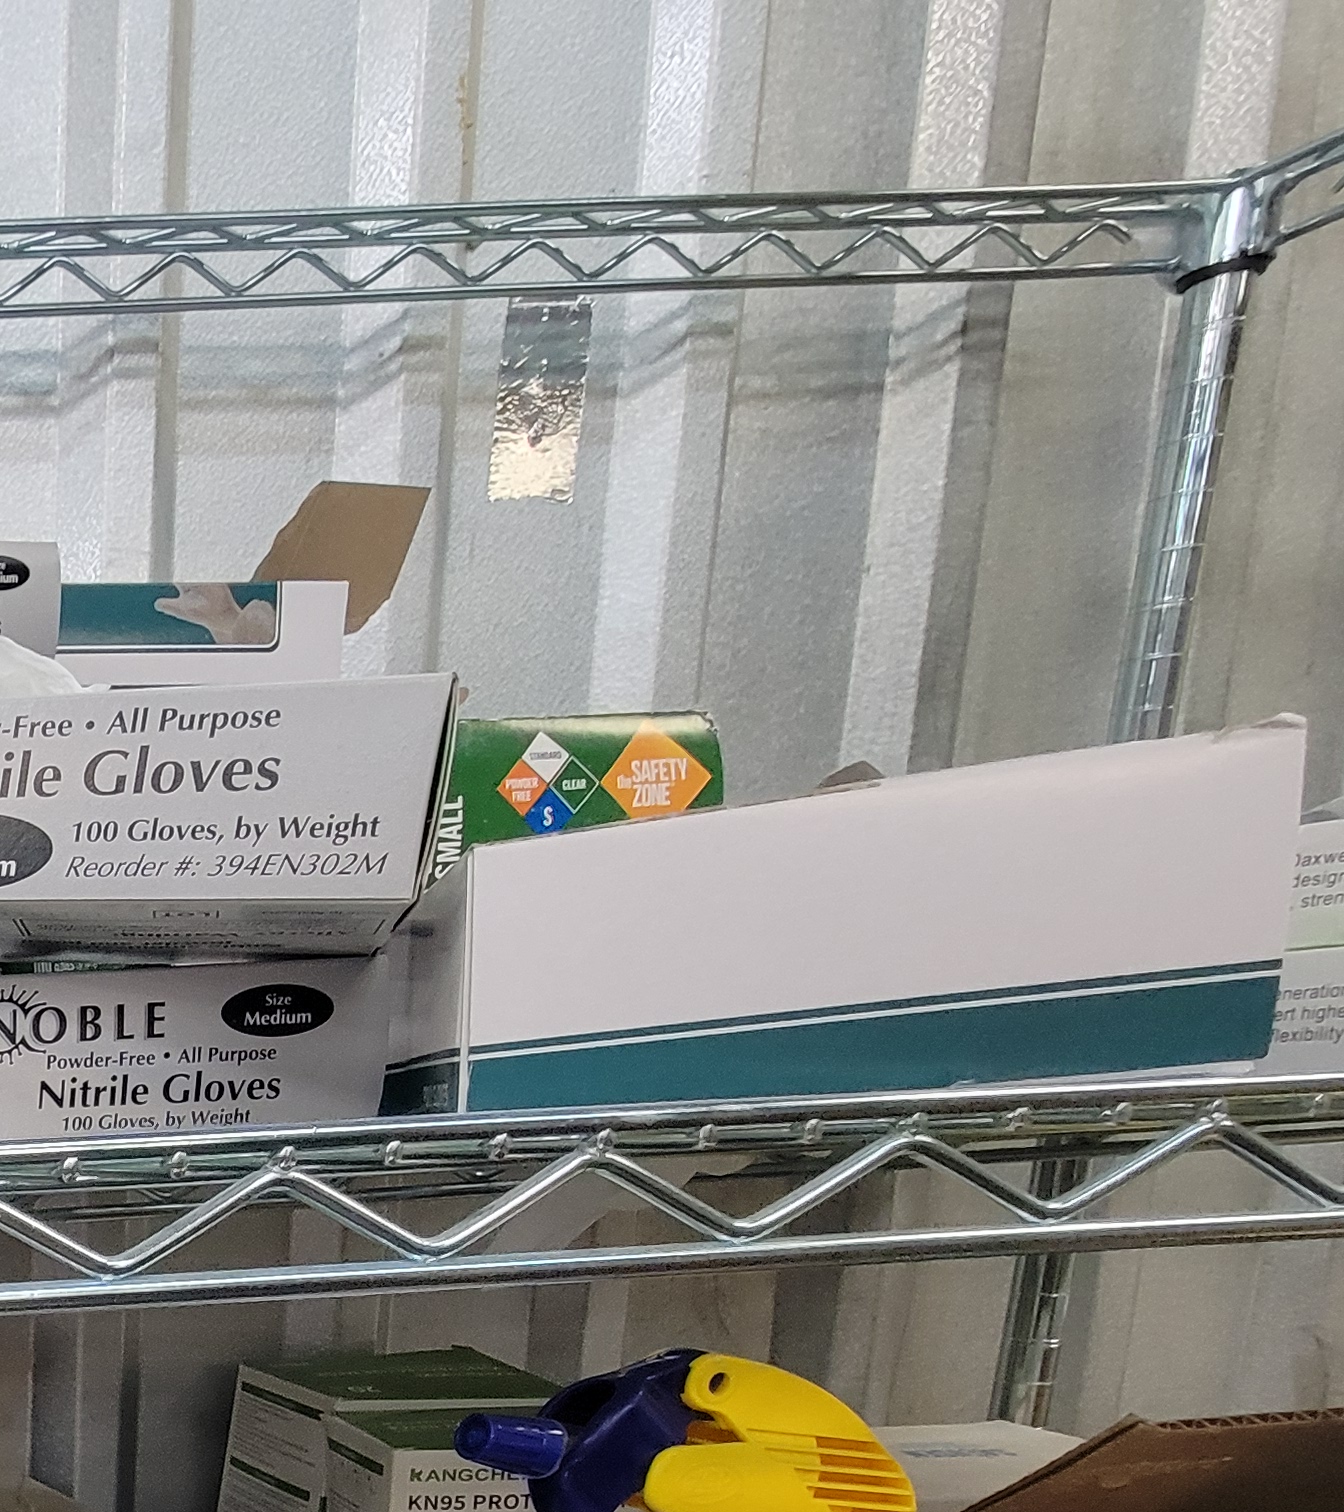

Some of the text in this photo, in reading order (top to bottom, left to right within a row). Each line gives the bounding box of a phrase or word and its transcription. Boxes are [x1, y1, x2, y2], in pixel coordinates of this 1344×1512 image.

[106, 708, 148, 735] All
[158, 709, 282, 734] Purpose
[83, 745, 281, 796] Gloves
[72, 814, 380, 846] 100 Gloves, by Weight
[66, 852, 389, 878] Reorder #: 394EN302M
[38, 1071, 281, 1110] Nitrile Gloves
[408, 1495, 465, 1510] KN95
